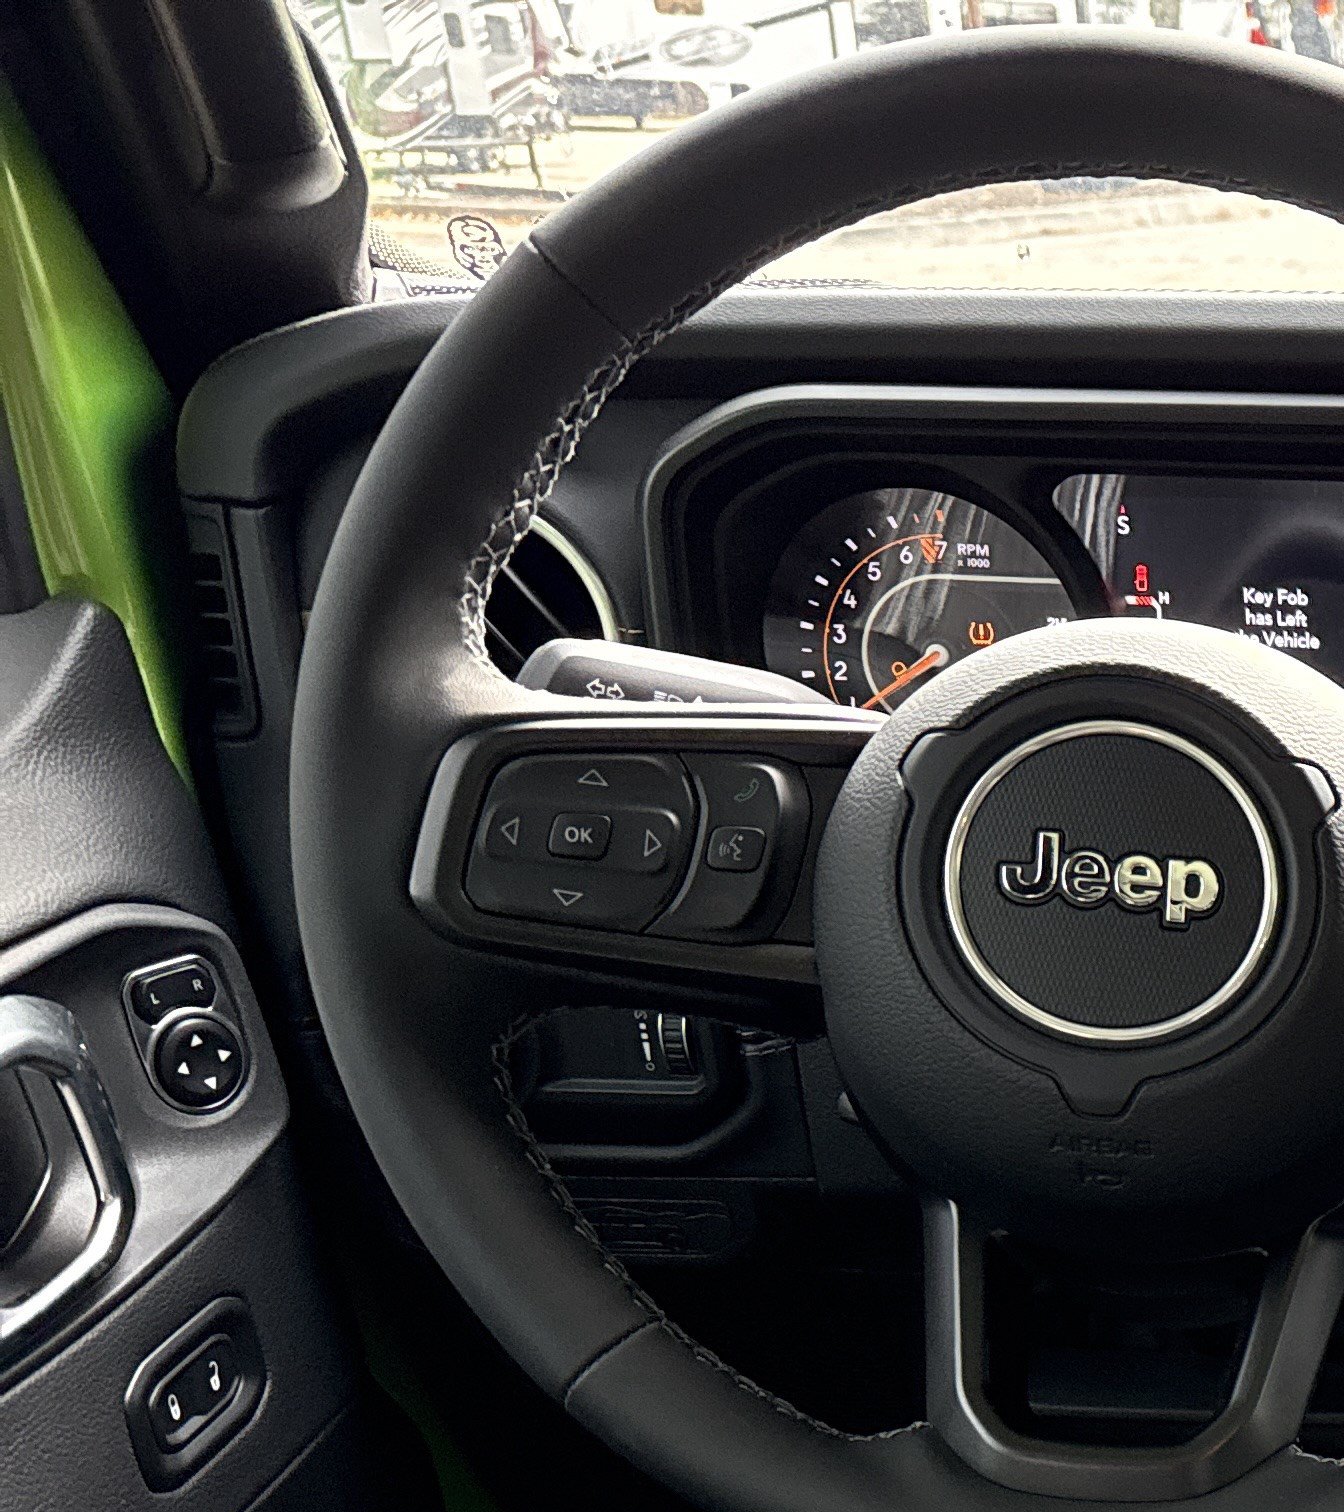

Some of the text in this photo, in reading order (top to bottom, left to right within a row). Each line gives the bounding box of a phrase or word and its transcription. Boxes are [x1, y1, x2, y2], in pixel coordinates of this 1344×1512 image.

[1117, 516, 1130, 534] S
[900, 546, 912, 564] 6
[957, 543, 989, 556] RPM
[868, 561, 881, 581] 5
[966, 558, 990, 568] 1000
[843, 589, 857, 608] 4
[1158, 591, 1169, 604] H
[1242, 587, 1309, 608] Key Fob
[1244, 608, 1308, 628] has Left
[833, 624, 846, 643] 3
[1262, 630, 1320, 649] Vehicle
[834, 662, 848, 680] 2
[565, 825, 593, 844] OK
[1001, 831, 1220, 923] Jeep
[192, 979, 204, 992] R
[150, 993, 160, 1004] L
